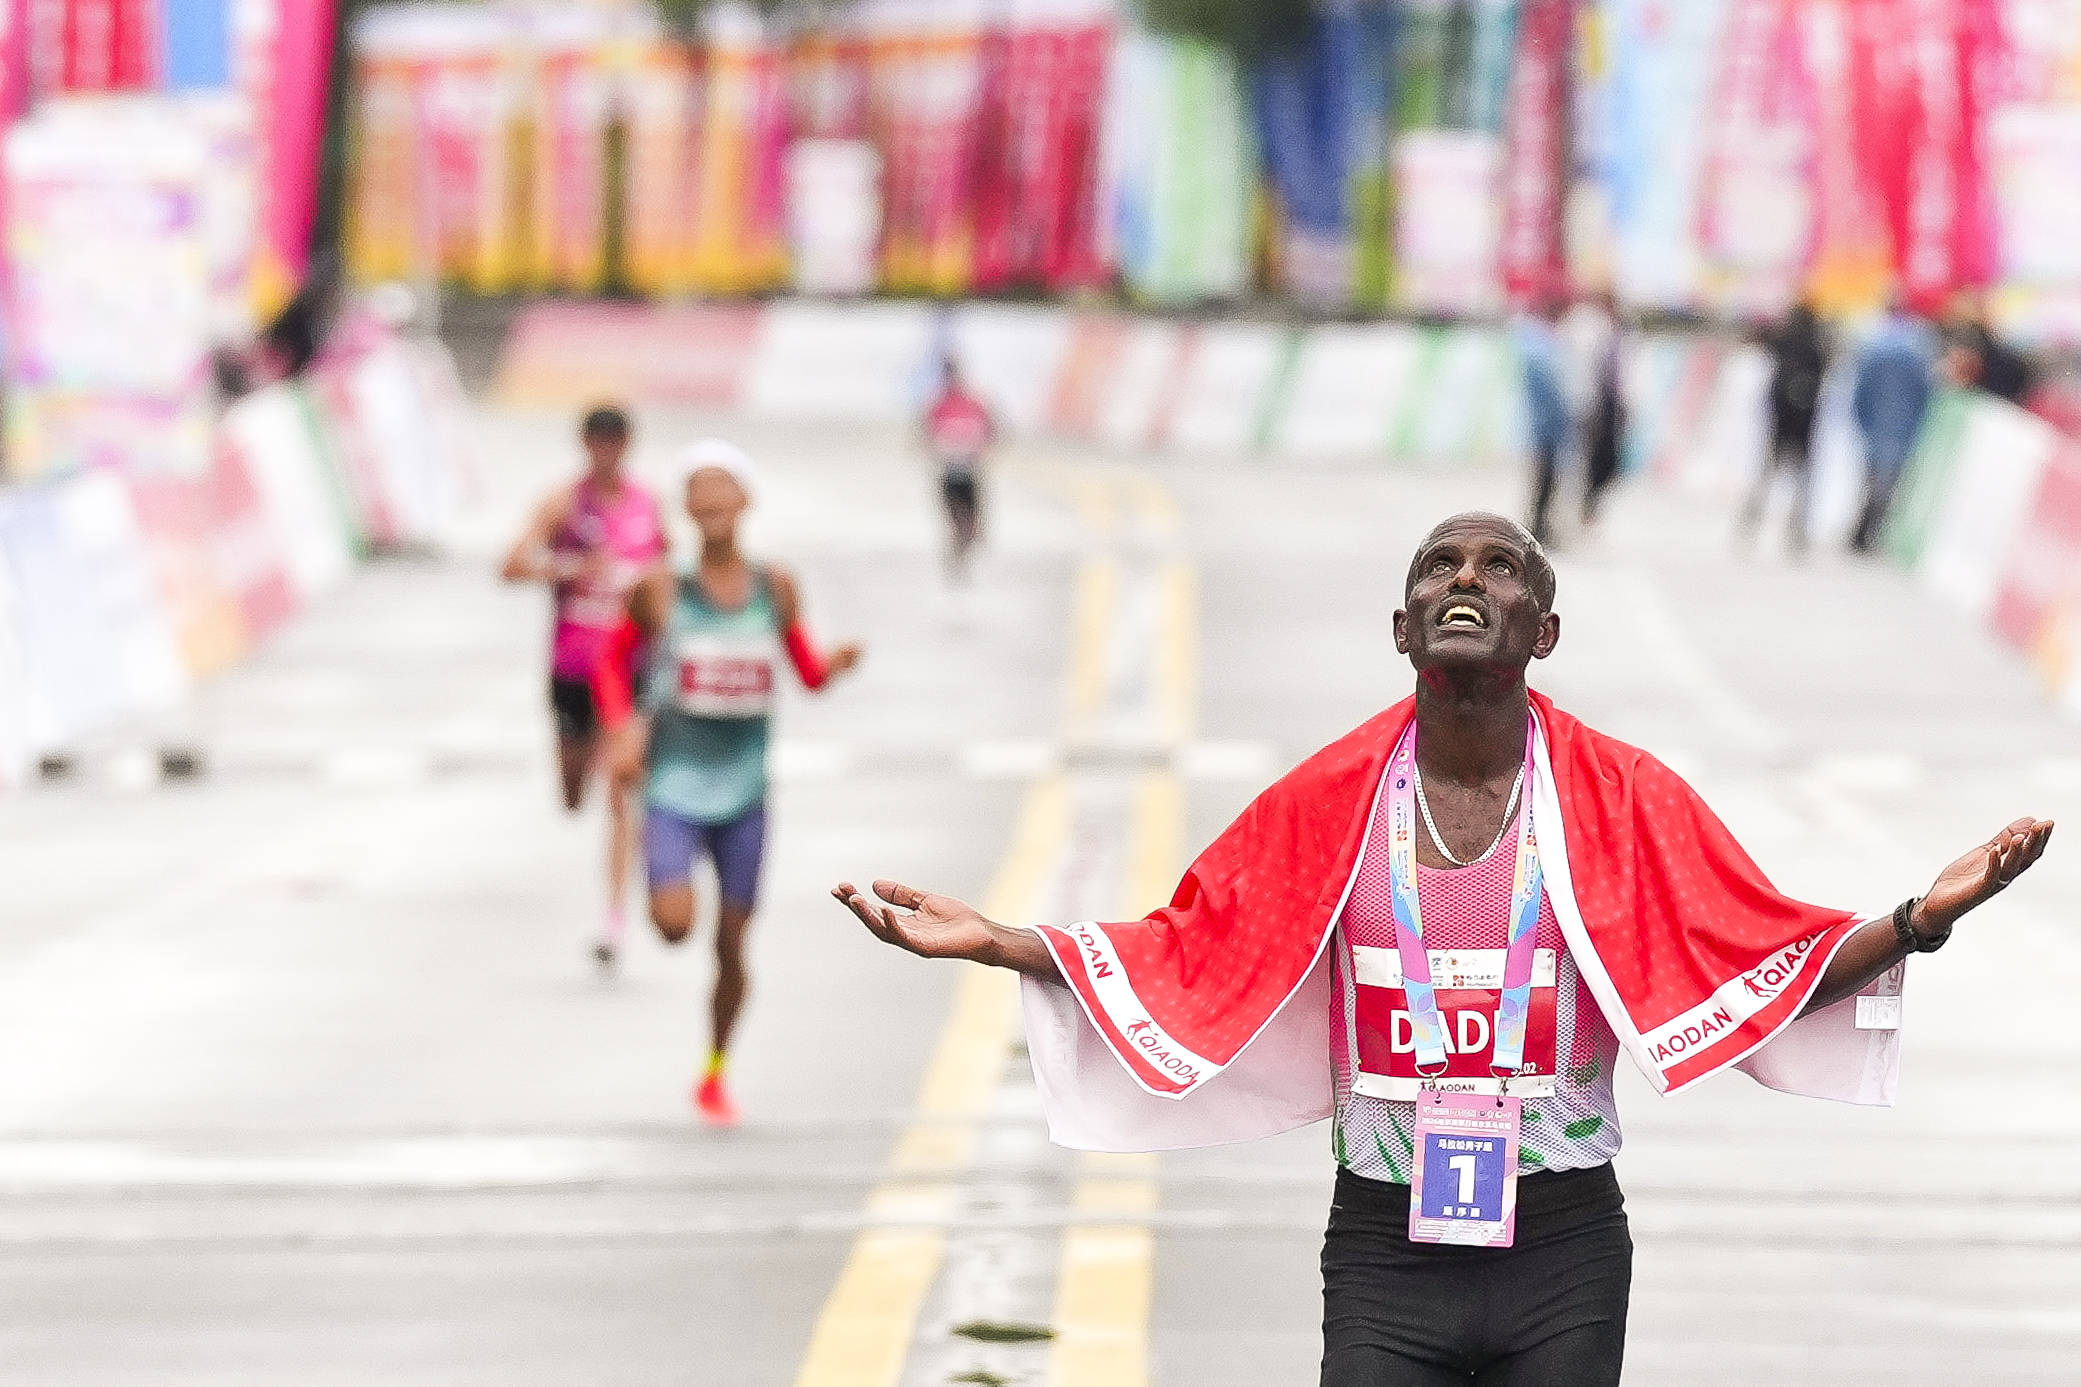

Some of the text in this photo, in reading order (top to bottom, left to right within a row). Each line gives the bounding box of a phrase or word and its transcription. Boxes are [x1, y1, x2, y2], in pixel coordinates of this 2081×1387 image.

[1763, 931, 1820, 986] QIAO
[1647, 1006, 1733, 1063] IAODAN
[1428, 1083, 1476, 1093] QAODAN
[1510, 1061, 1537, 1075] 02
[1449, 1154, 1477, 1205] 1
